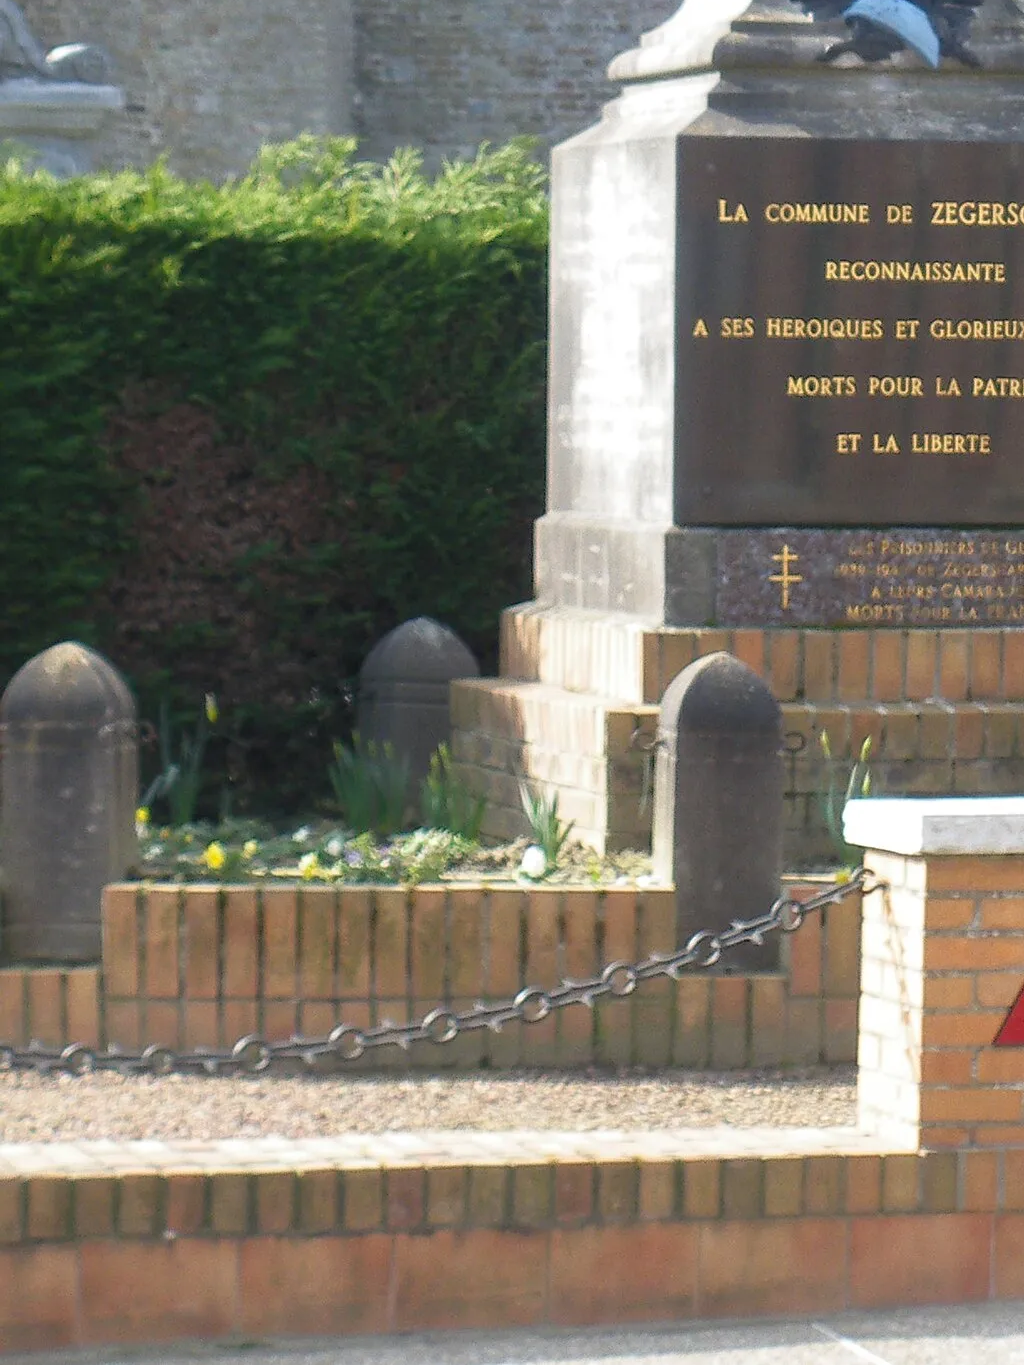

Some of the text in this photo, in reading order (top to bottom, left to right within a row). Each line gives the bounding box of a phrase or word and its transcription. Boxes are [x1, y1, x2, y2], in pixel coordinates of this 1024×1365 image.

[719, 199, 748, 222] LA
[765, 204, 868, 224] COMMUNE
[887, 206, 912, 224] DE
[825, 261, 1005, 282] RECONNAISSANTE
[694, 319, 708, 338] A
[721, 318, 753, 338] SES
[767, 318, 883, 339] HEROIQUES
[896, 320, 920, 339] ET
[787, 377, 856, 396] MORTS
[869, 378, 923, 396] POUR
[936, 378, 961, 396] LA
[837, 434, 990, 454] ET LA LIBERTE
[871, 586, 882, 599] A
[845, 604, 904, 620] MORTS
